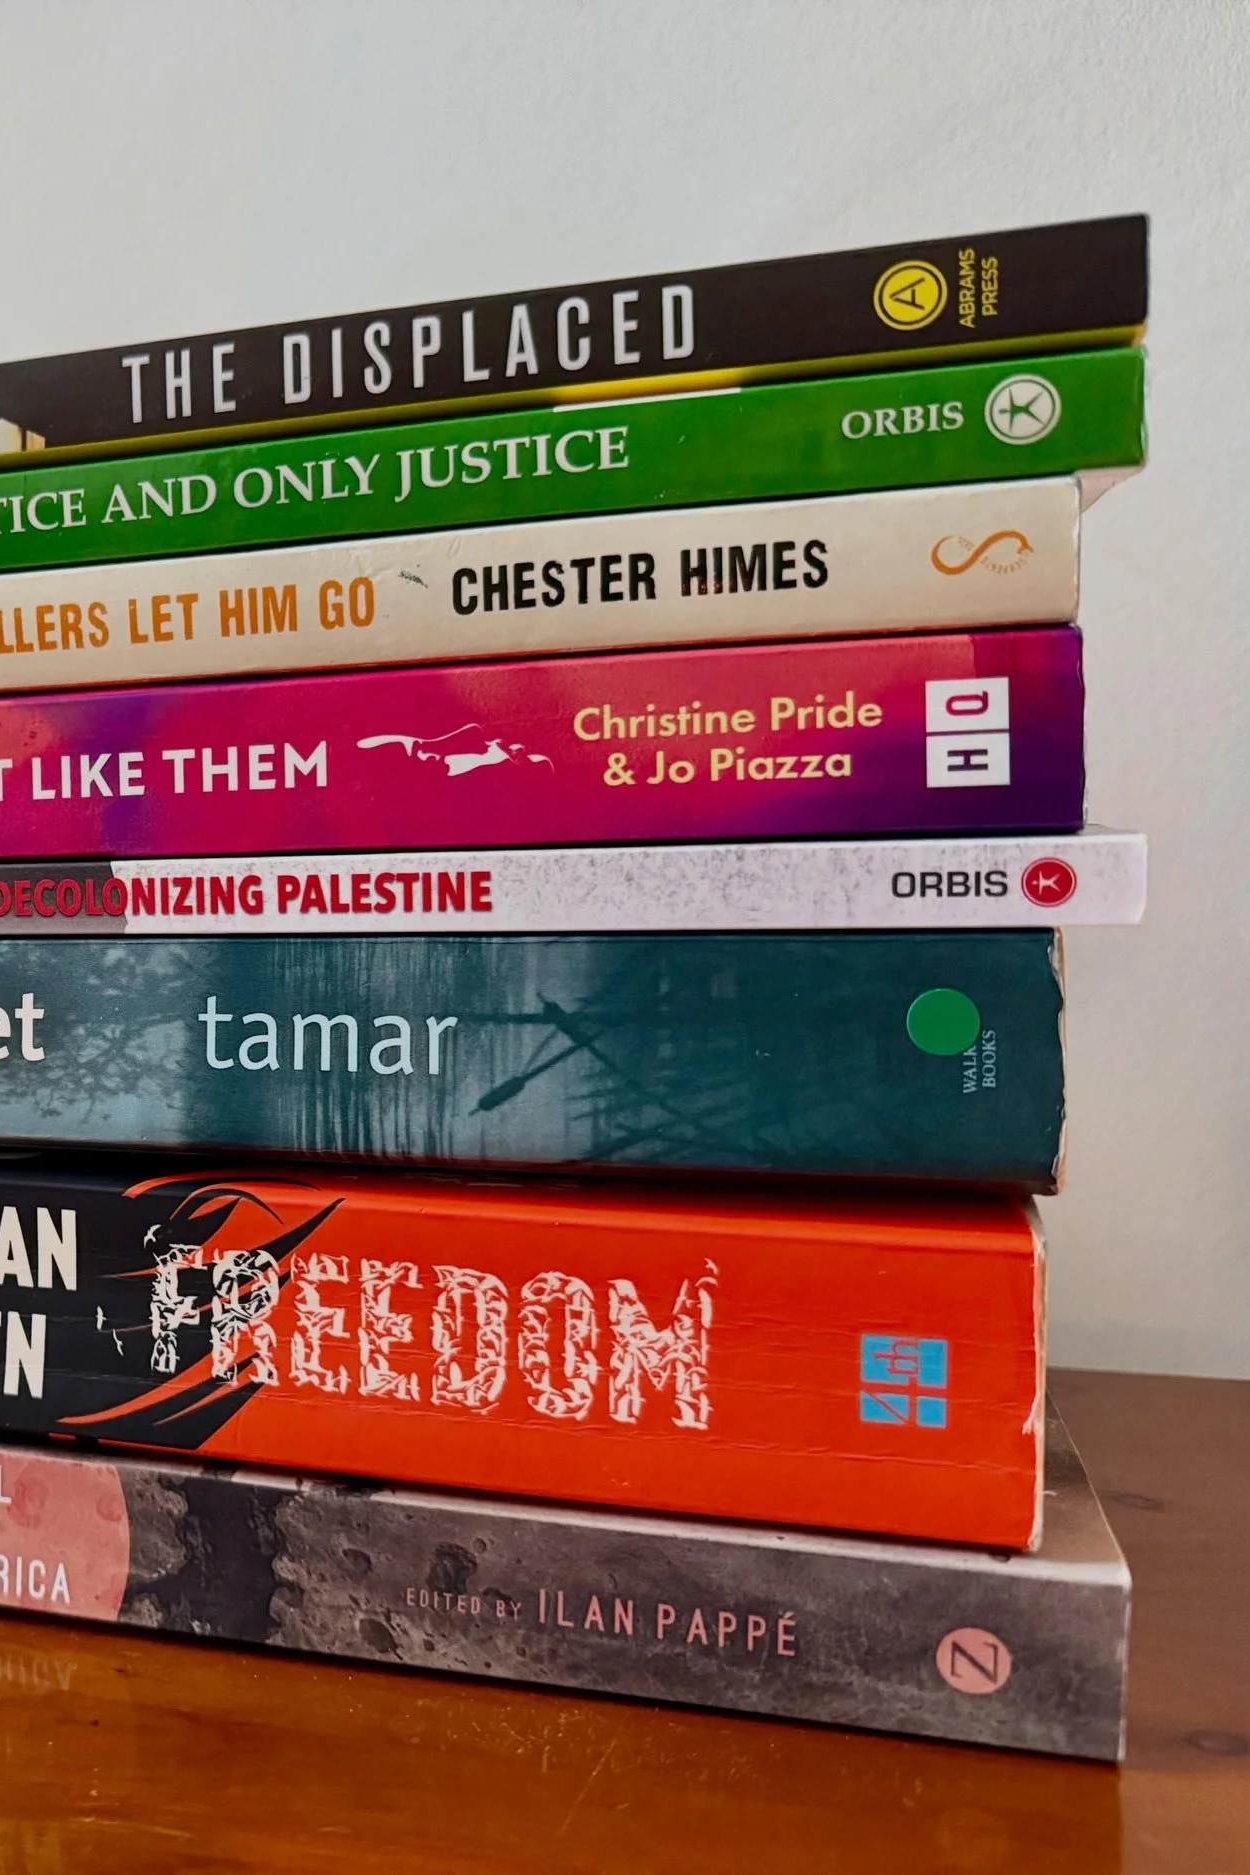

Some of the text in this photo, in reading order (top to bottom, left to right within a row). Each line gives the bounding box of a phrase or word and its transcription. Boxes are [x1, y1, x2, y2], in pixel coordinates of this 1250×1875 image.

[958, 247, 976, 329] ABRAMS
[981, 256, 999, 316] PRESS
[122, 284, 696, 424] THE DISPLACED
[841, 401, 965, 440] ORBIS
[103, 474, 218, 524] AND
[233, 453, 382, 510] ONLY
[395, 426, 630, 503] JUSTICE
[451, 539, 830, 616] CHESTER HIMES
[128, 594, 195, 645] LET
[219, 583, 299, 638] HIM
[318, 576, 376, 629] GO
[573, 690, 884, 743] Christine Pride
[31, 751, 147, 800] LIKE
[161, 740, 330, 795] THEM
[602, 746, 854, 786] & Jo Piazza
[277, 870, 494, 915] PALESTINE
[890, 869, 1009, 899] ORBIS
[198, 994, 460, 1077] tamar
[982, 1030, 997, 1088] BOOKS
[963, 1045, 978, 1094] WALK
[150, 1242, 720, 1431] FREEDOM
[406, 1587, 797, 1657] EDITED BY ILAN PAPPÉ
